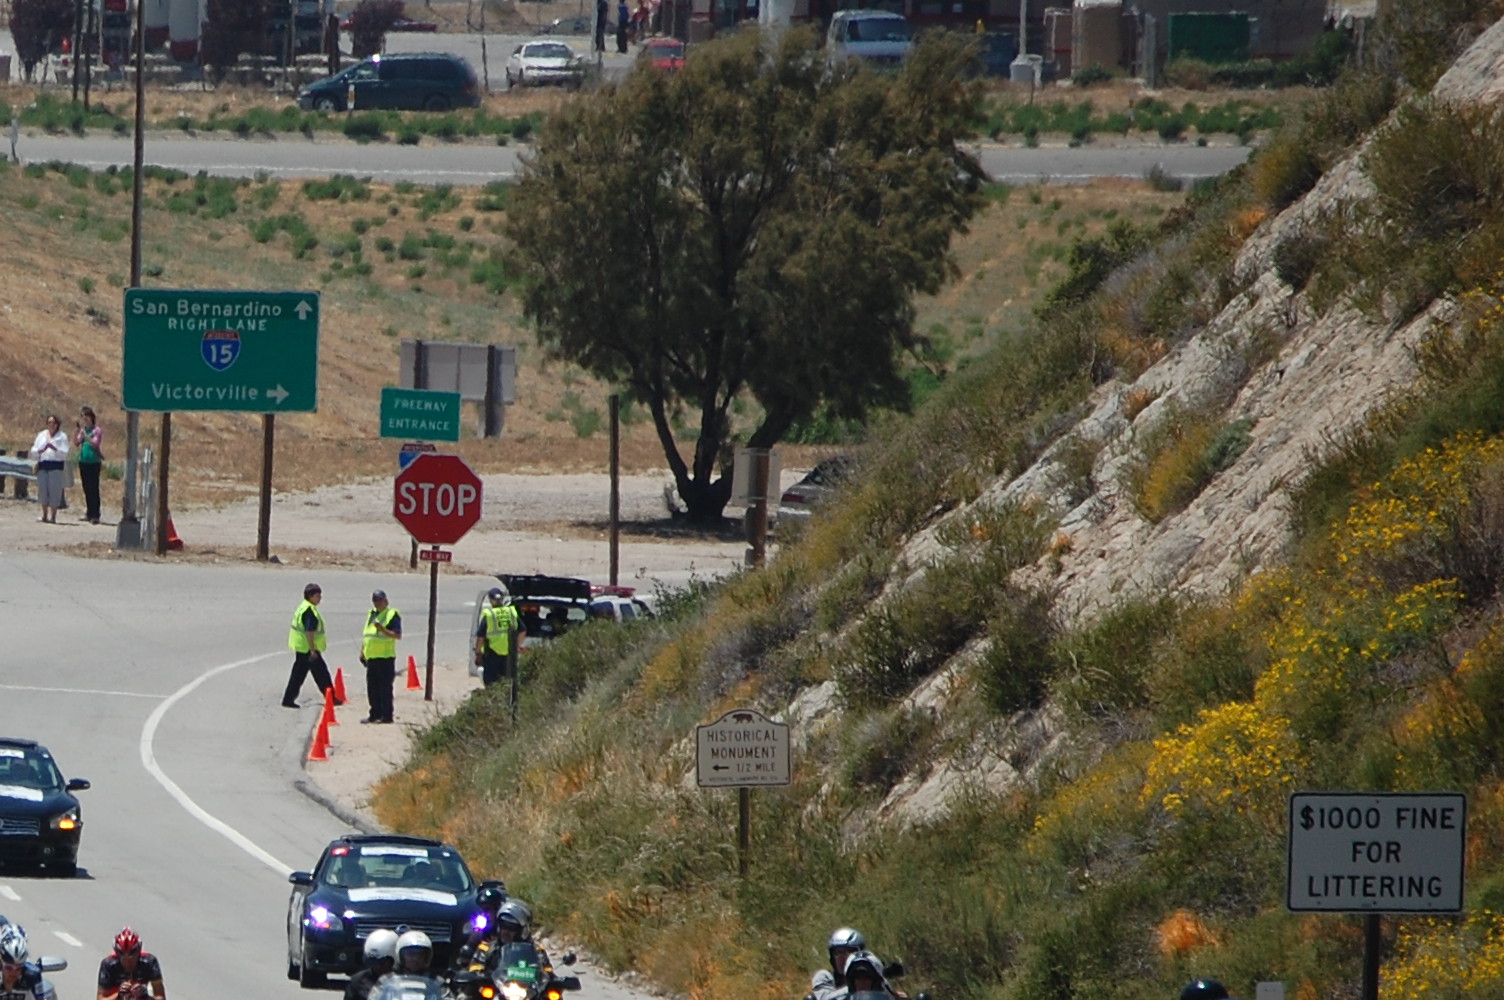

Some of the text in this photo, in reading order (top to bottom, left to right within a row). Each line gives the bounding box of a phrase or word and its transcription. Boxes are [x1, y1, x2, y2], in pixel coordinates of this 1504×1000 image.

[132, 298, 282, 317] San Bernardino
[168, 317, 267, 331] RIGHT LANE
[210, 344, 233, 364] 15
[152, 382, 259, 401] Victorville
[394, 399, 448, 412] FREEWAY
[388, 417, 450, 432] ENTRANCE
[398, 481, 477, 517] STOP
[707, 729, 778, 742] HISTORICAL
[711, 746, 776, 759] MONUMENT
[736, 762, 776, 773] 1/2 MILE
[1300, 804, 1455, 831] $1000 FINE
[1352, 841, 1402, 864] FOR
[1308, 875, 1442, 898] LITTERING
